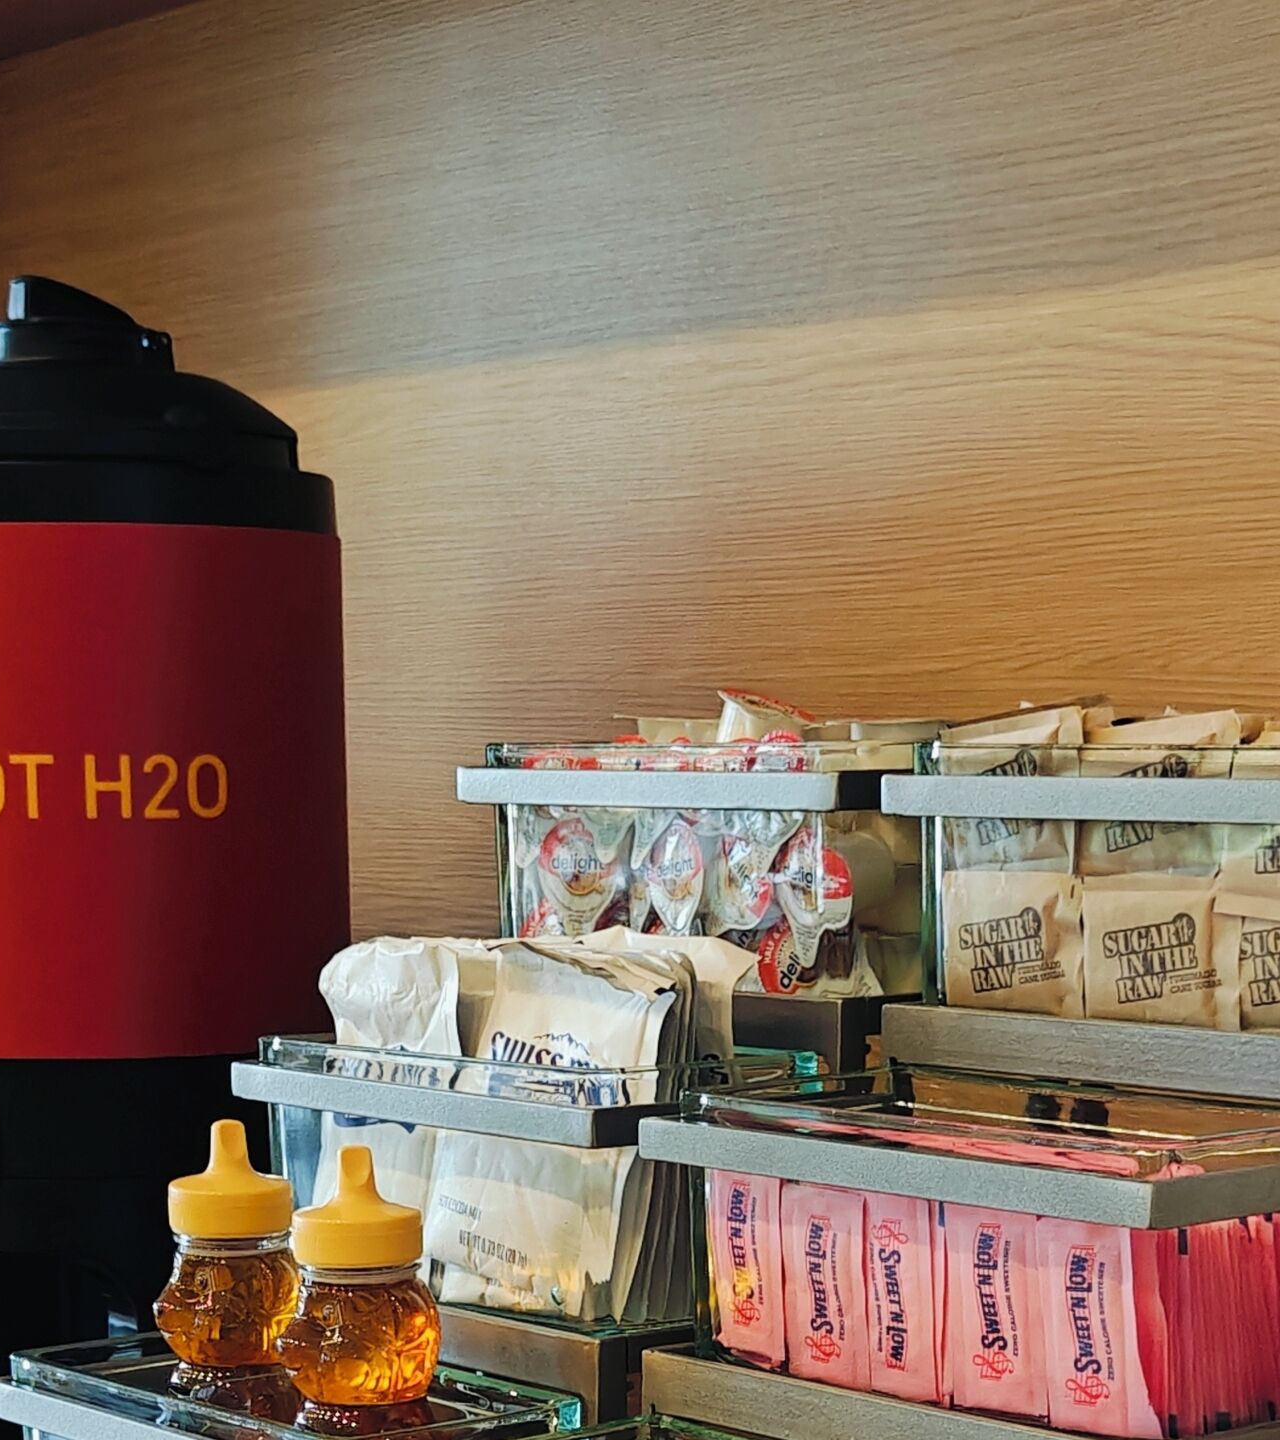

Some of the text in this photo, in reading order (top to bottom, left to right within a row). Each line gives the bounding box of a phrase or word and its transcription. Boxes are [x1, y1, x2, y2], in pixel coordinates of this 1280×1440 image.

[959, 915, 1023, 950] SUGAR
[1103, 922, 1178, 958] SUGAR
[973, 936, 1044, 970] IN THE
[1120, 944, 1198, 978] IN THE
[1253, 955, 1280, 980] IN
[971, 965, 1015, 993] RAW
[1116, 972, 1167, 1004] RAW
